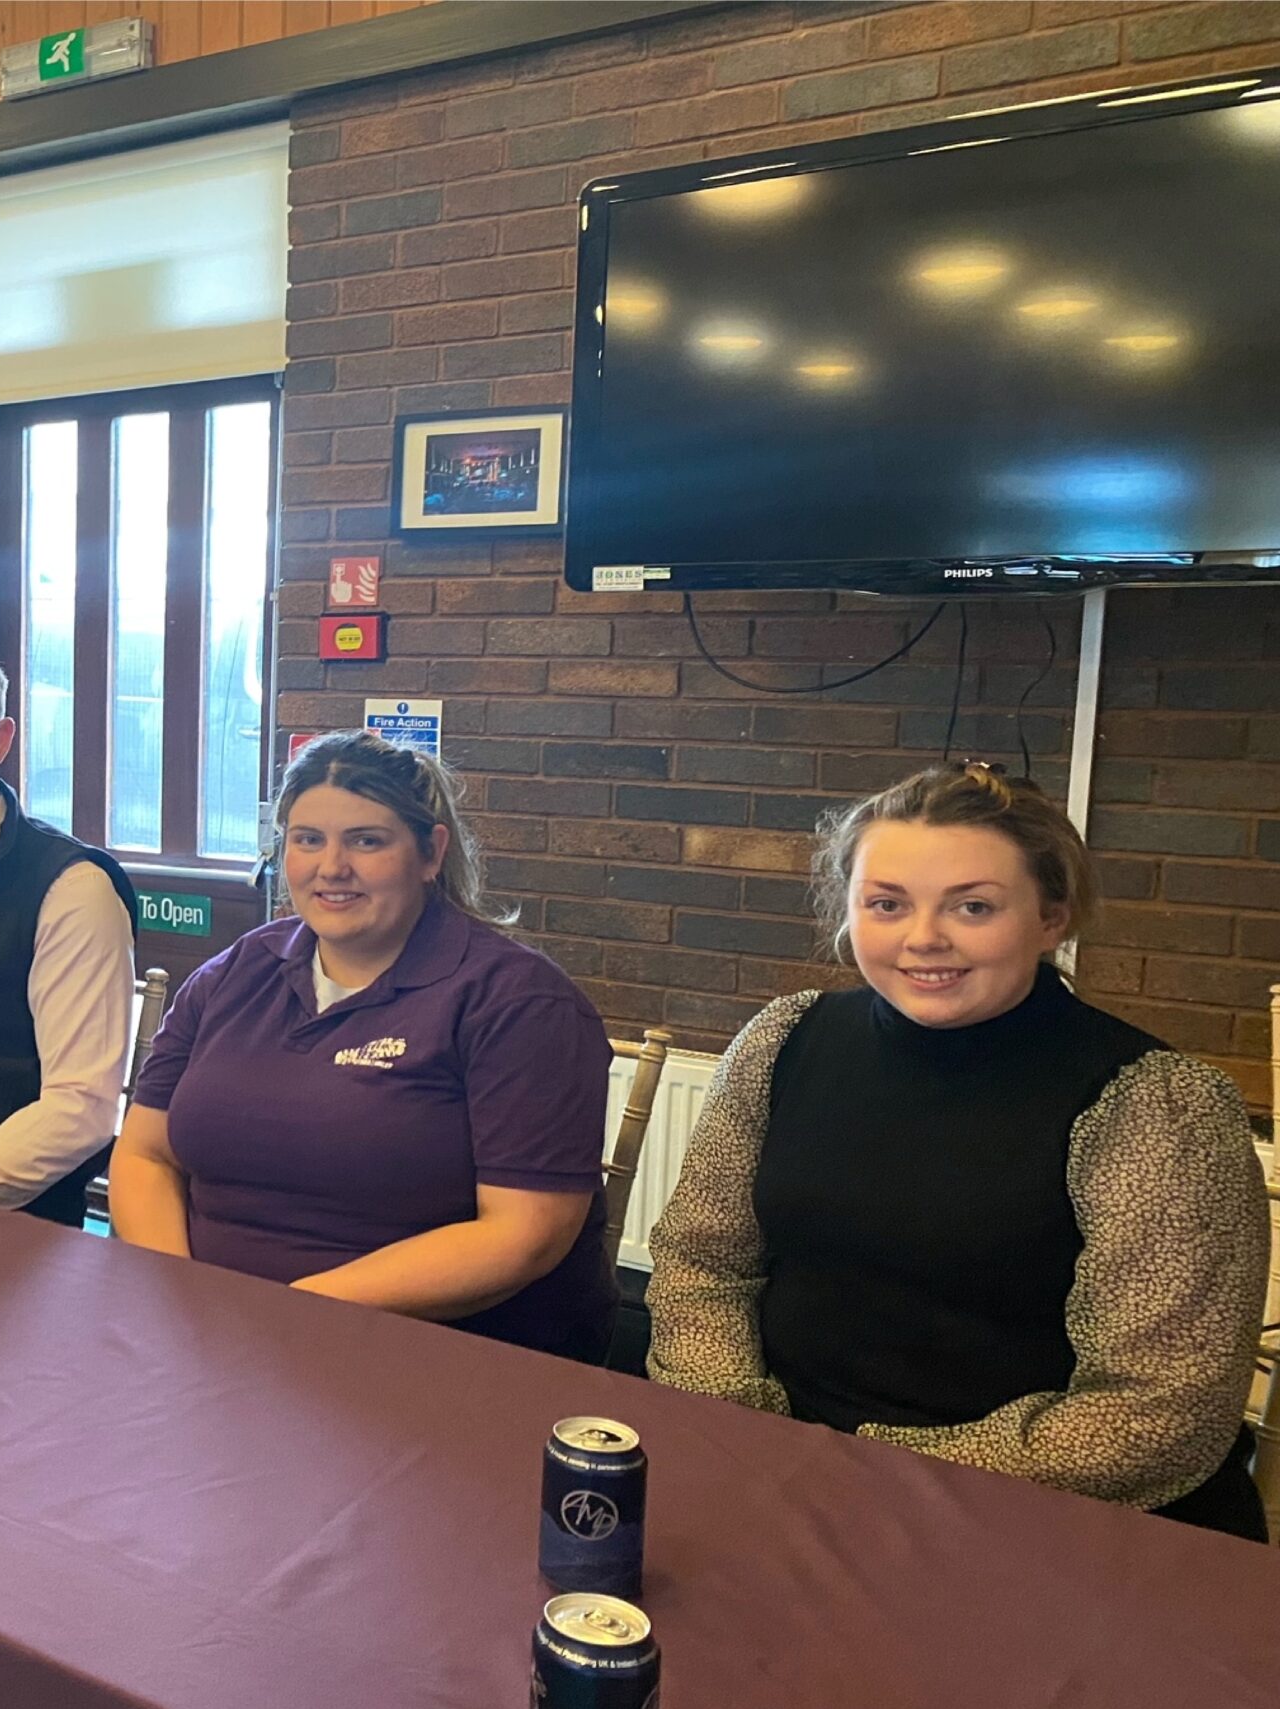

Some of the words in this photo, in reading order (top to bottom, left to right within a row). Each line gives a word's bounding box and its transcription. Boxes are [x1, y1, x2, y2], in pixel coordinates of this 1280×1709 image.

[595, 570, 642, 579] JONES
[944, 568, 993, 578] PHILIPS
[374, 717, 395, 727] Fire
[396, 717, 431, 728] Action
[139, 895, 157, 919] To
[161, 897, 203, 927] Open
